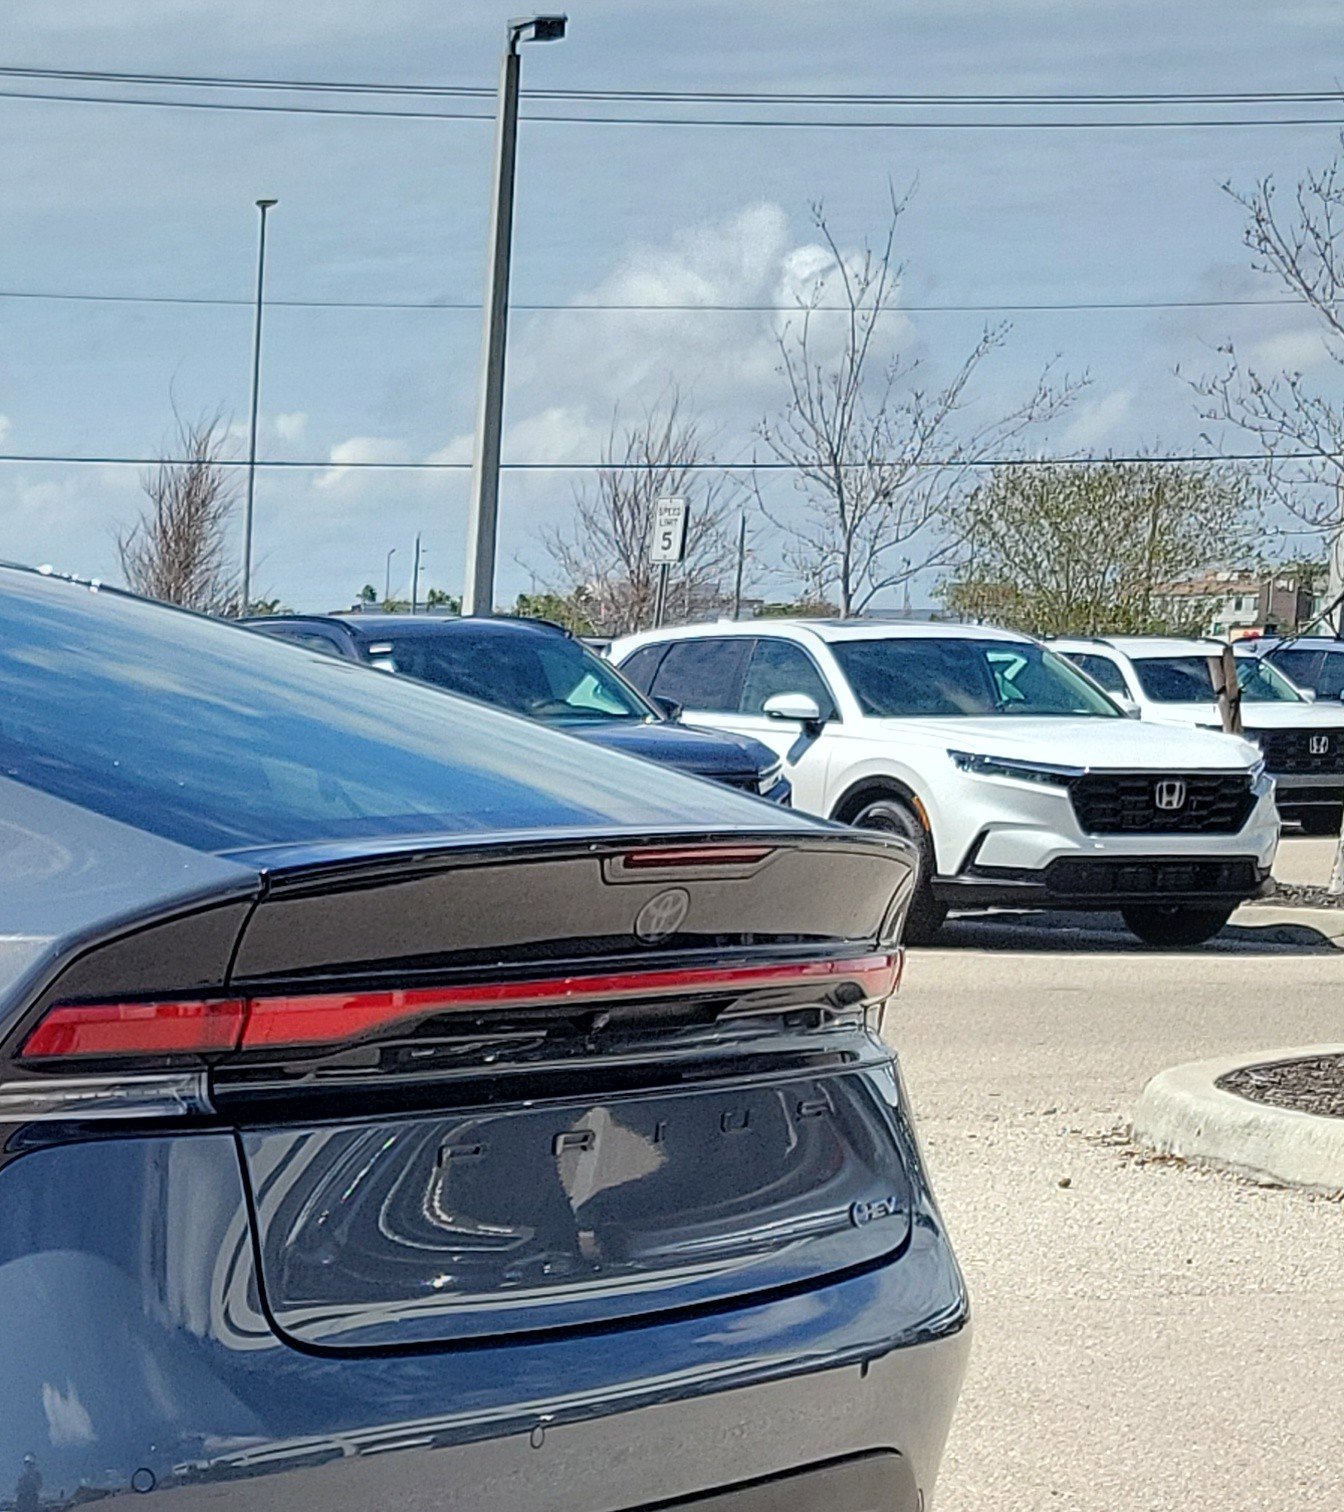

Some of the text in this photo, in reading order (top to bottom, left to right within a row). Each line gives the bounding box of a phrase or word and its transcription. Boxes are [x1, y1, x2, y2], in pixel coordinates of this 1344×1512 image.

[659, 507, 681, 516] SPEED
[659, 518, 678, 527] LIMIT
[661, 531, 672, 550] 5
[437, 1100, 836, 1168] PRIUS
[863, 1196, 896, 1222] HEV
